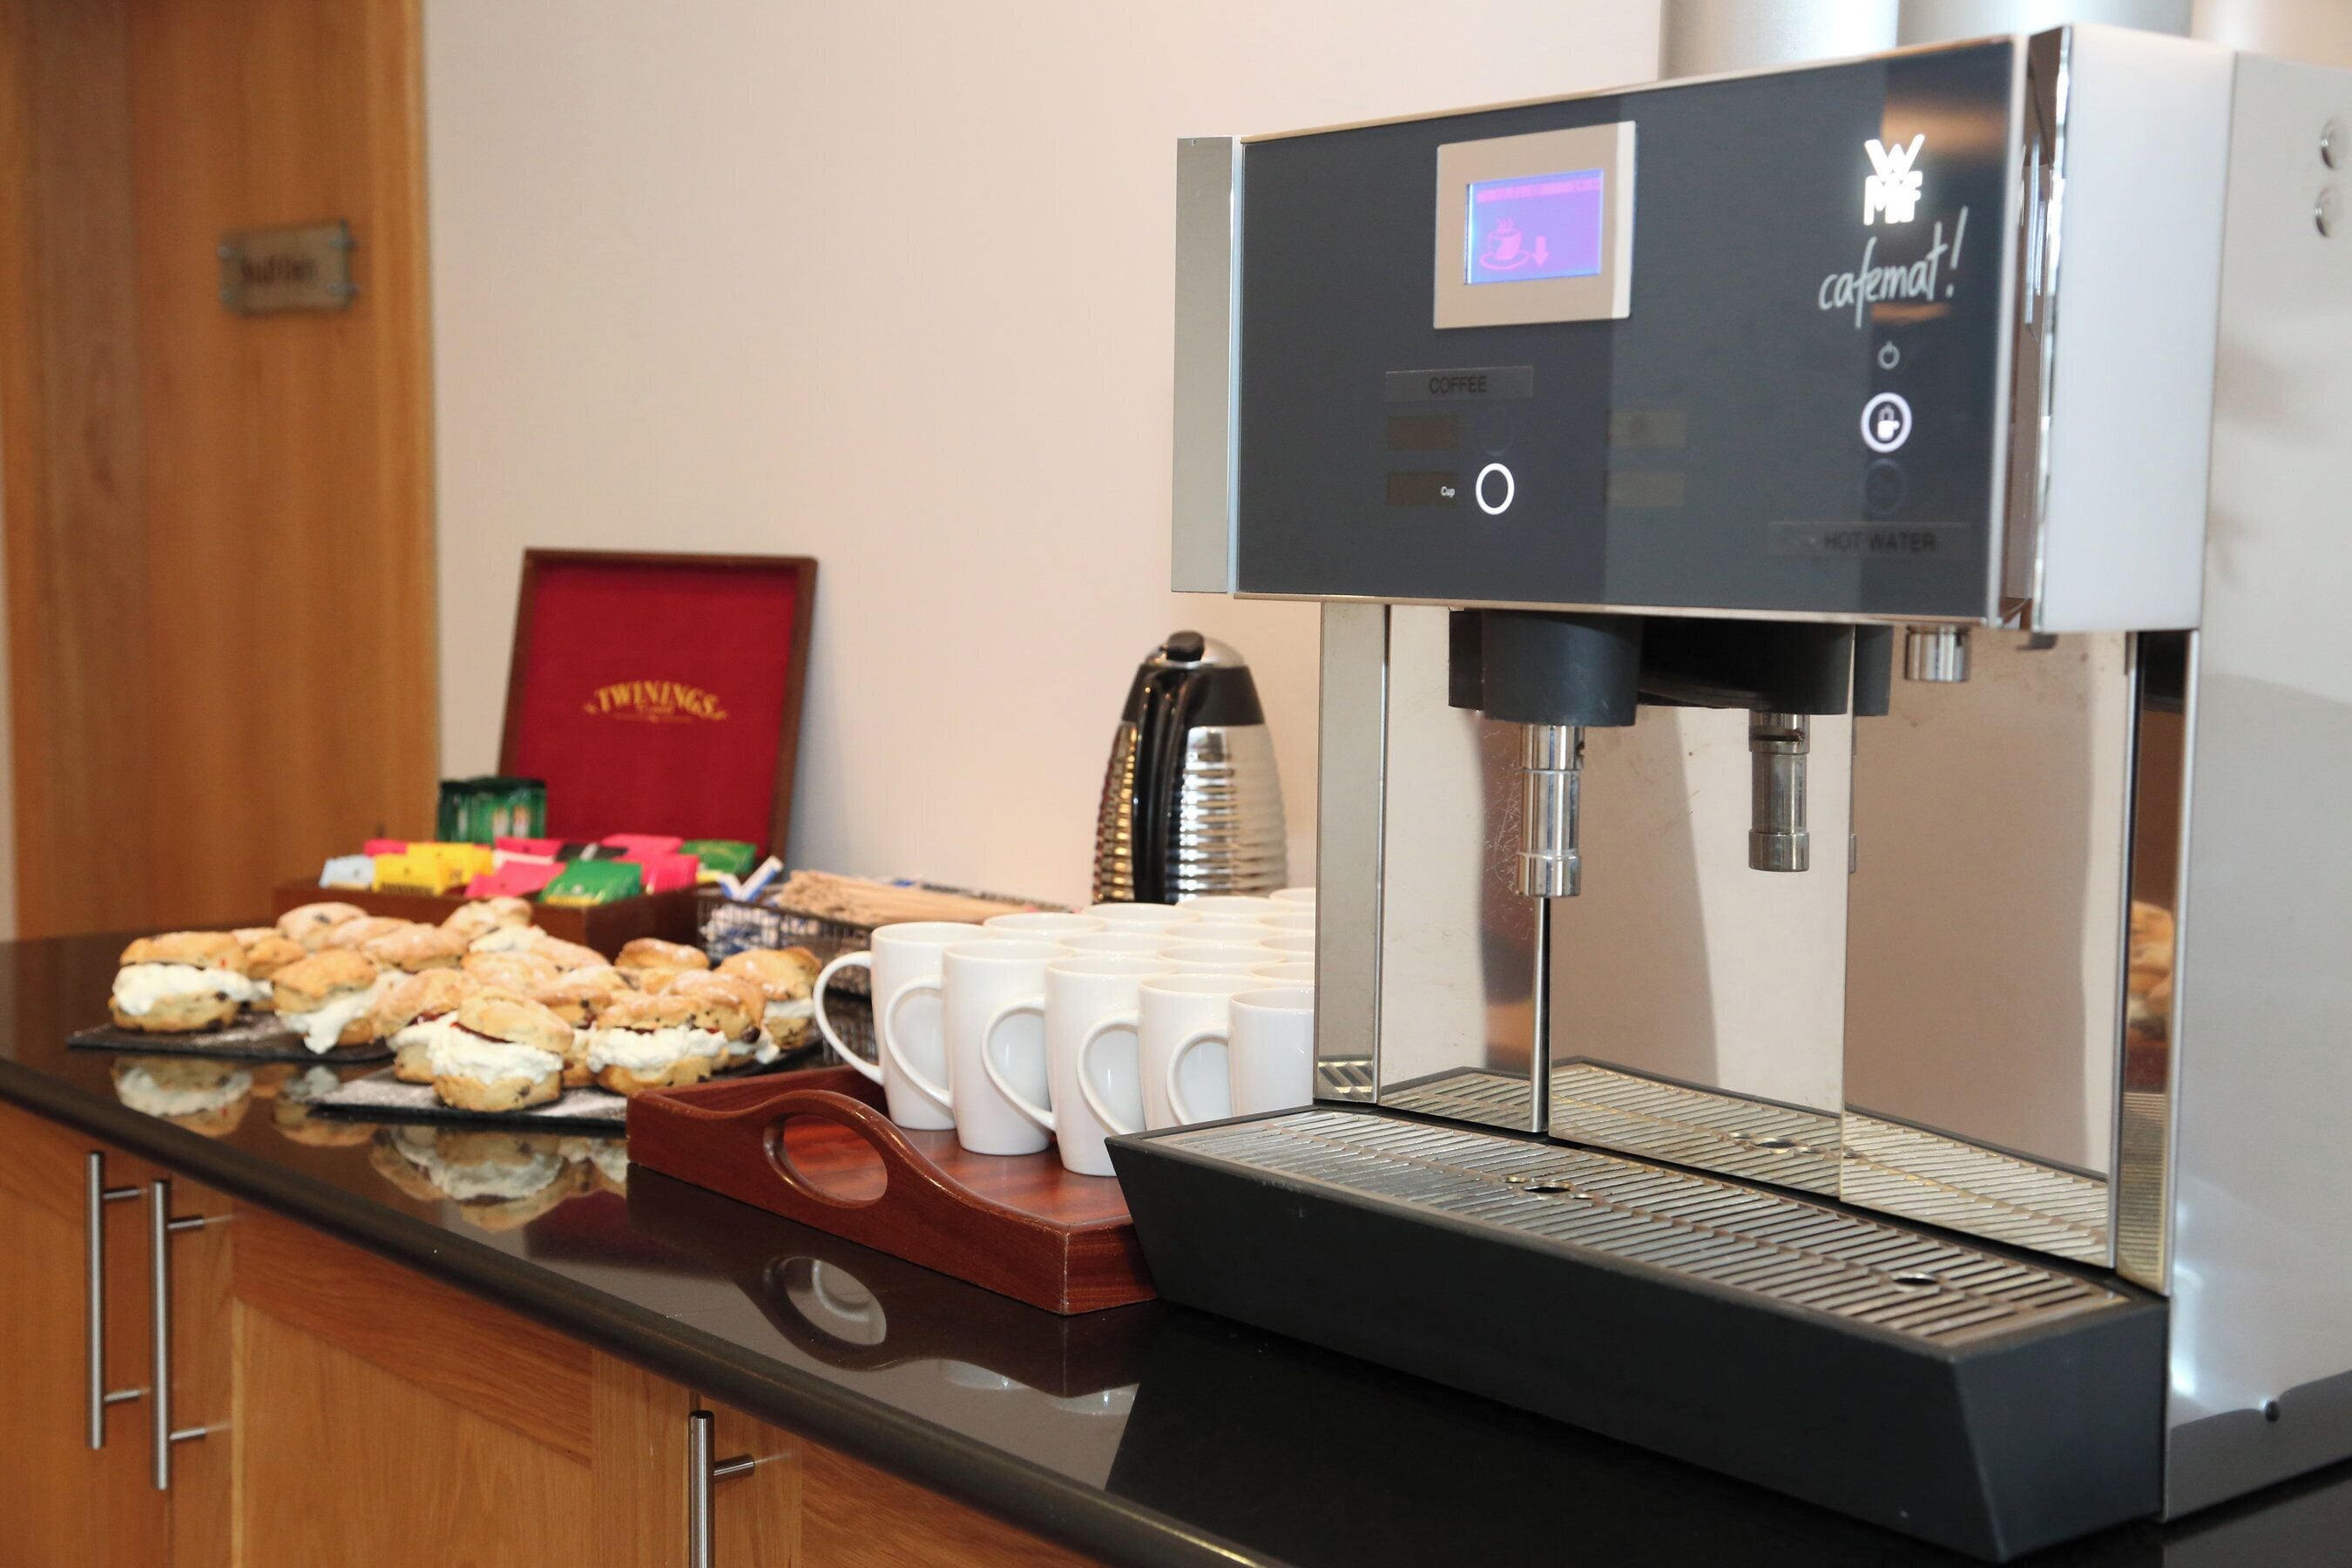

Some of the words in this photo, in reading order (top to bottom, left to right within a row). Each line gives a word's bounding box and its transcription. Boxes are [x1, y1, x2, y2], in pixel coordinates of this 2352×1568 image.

[1863, 134, 1925, 226] WMF
[1429, 375, 1487, 394] COFFEE
[1440, 485, 1456, 498] Cup
[1824, 531, 1862, 551] HOT
[1869, 531, 1936, 552] WATER
[593, 679, 720, 720] TWININGS
